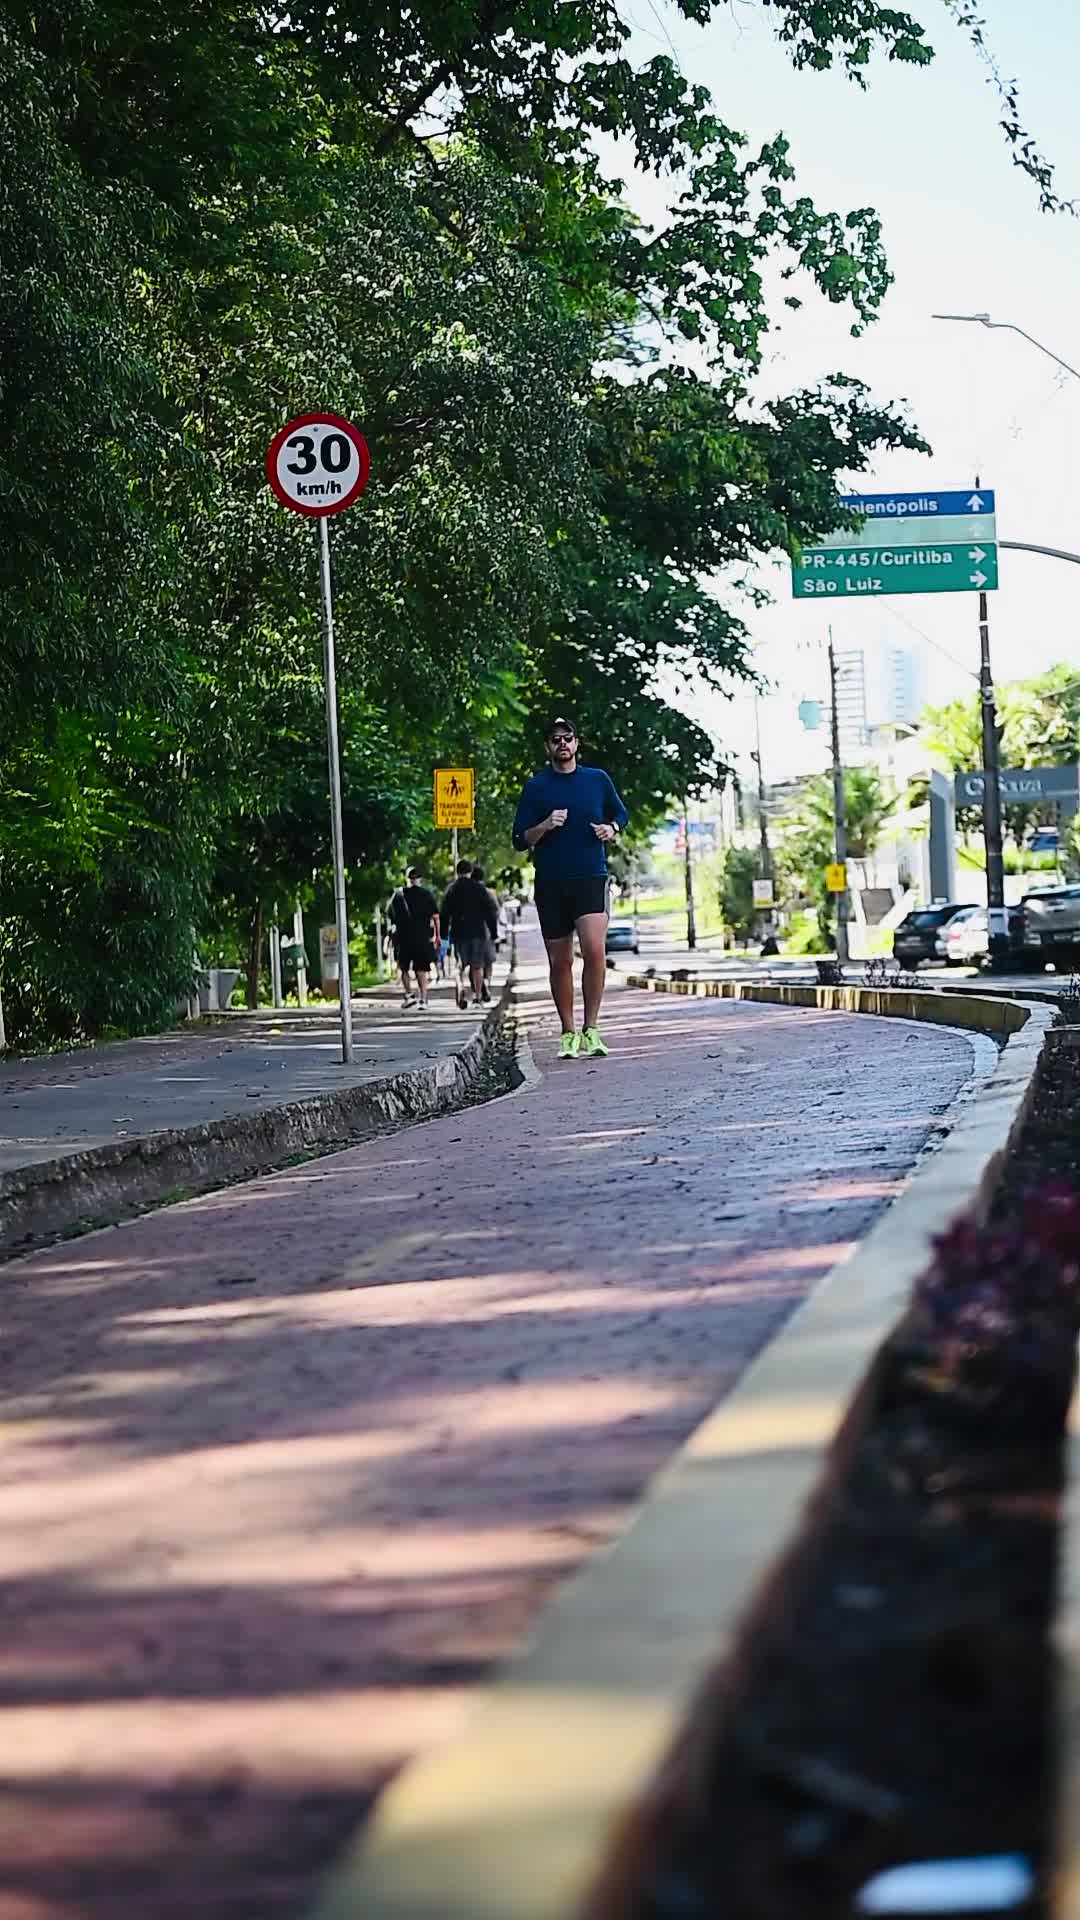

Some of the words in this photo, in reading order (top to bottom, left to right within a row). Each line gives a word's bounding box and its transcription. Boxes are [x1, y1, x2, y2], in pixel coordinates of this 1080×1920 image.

[286, 433, 351, 475] 30
[296, 480, 342, 496] km/h
[801, 550, 953, 568] PR-445/Curitiba
[803, 578, 837, 593] São
[845, 576, 883, 591] Luiz
